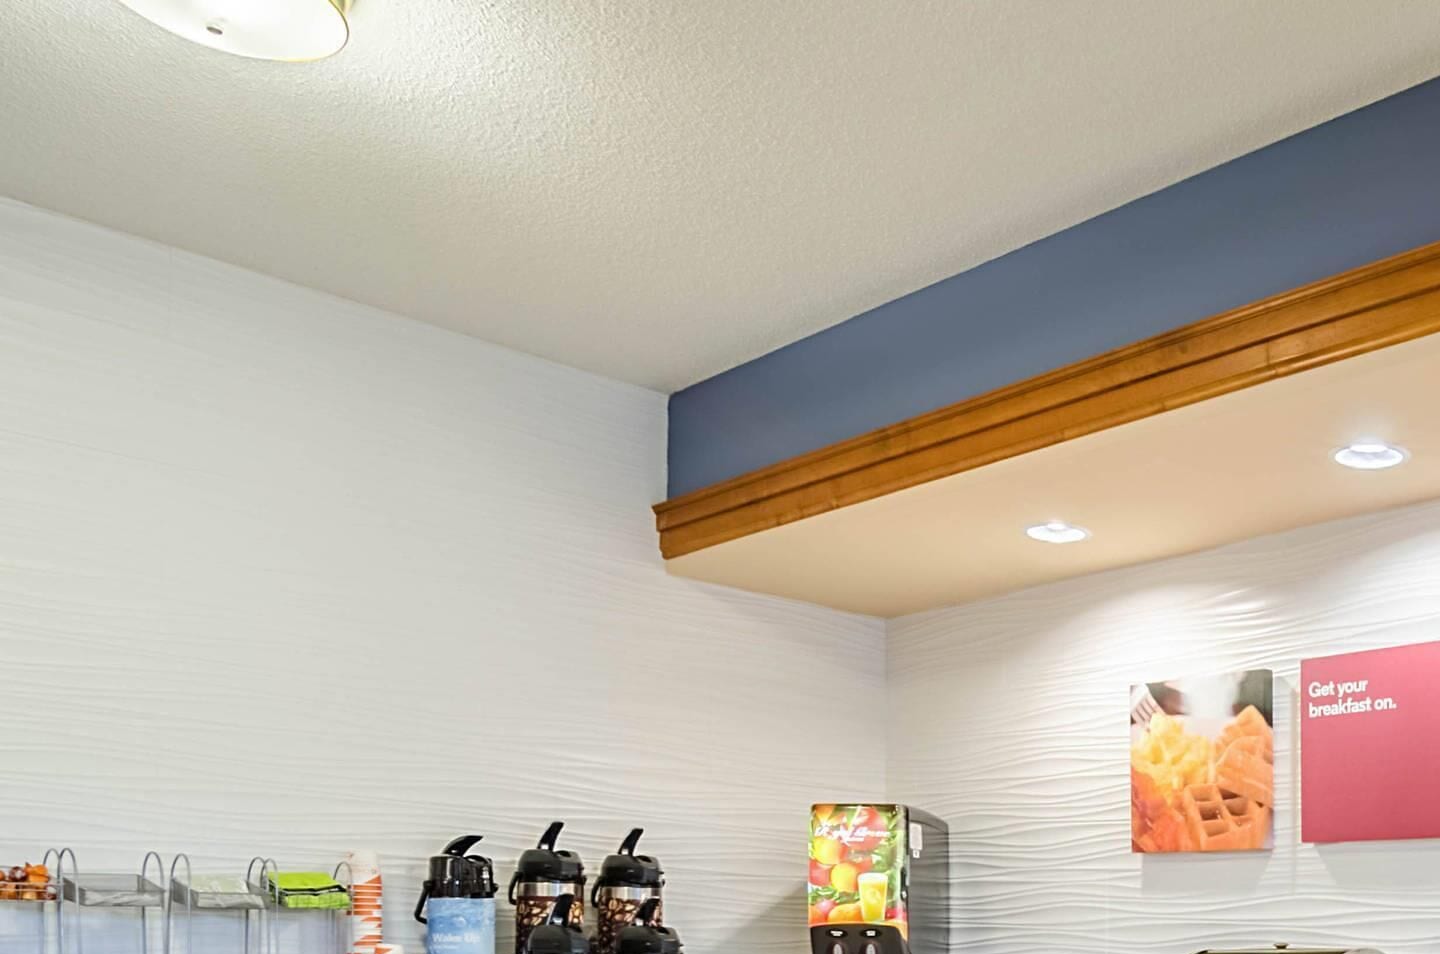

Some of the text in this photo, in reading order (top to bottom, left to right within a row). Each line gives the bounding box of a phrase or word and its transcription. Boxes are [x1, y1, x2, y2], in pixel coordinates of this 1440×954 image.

[1308, 680, 1369, 698] Get your
[1308, 697, 1397, 718] breakfast on.
